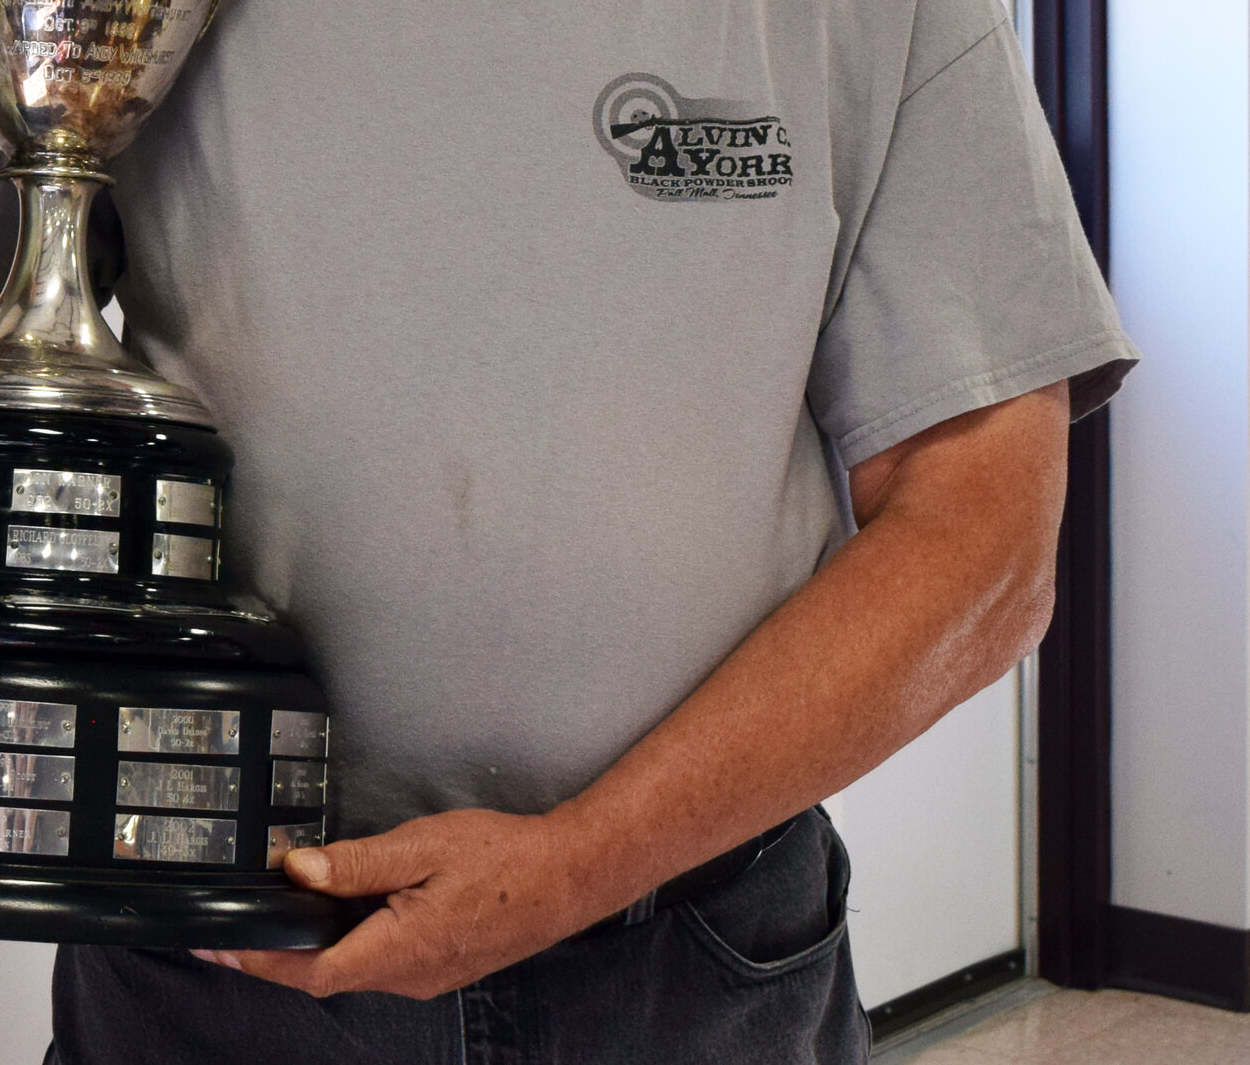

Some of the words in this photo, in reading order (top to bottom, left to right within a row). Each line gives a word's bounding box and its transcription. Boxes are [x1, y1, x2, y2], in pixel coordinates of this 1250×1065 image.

[62, 40, 82, 60] TO
[83, 41, 119, 62] ANDY
[630, 124, 772, 177] ALVIN
[629, 175, 681, 188] BLACK
[684, 176, 745, 188] POWDER
[722, 189, 779, 200] Tennessee
[12, 529, 56, 543] RICHARD
[172, 769, 194, 780] 2001
[165, 820, 196, 833] 2002
